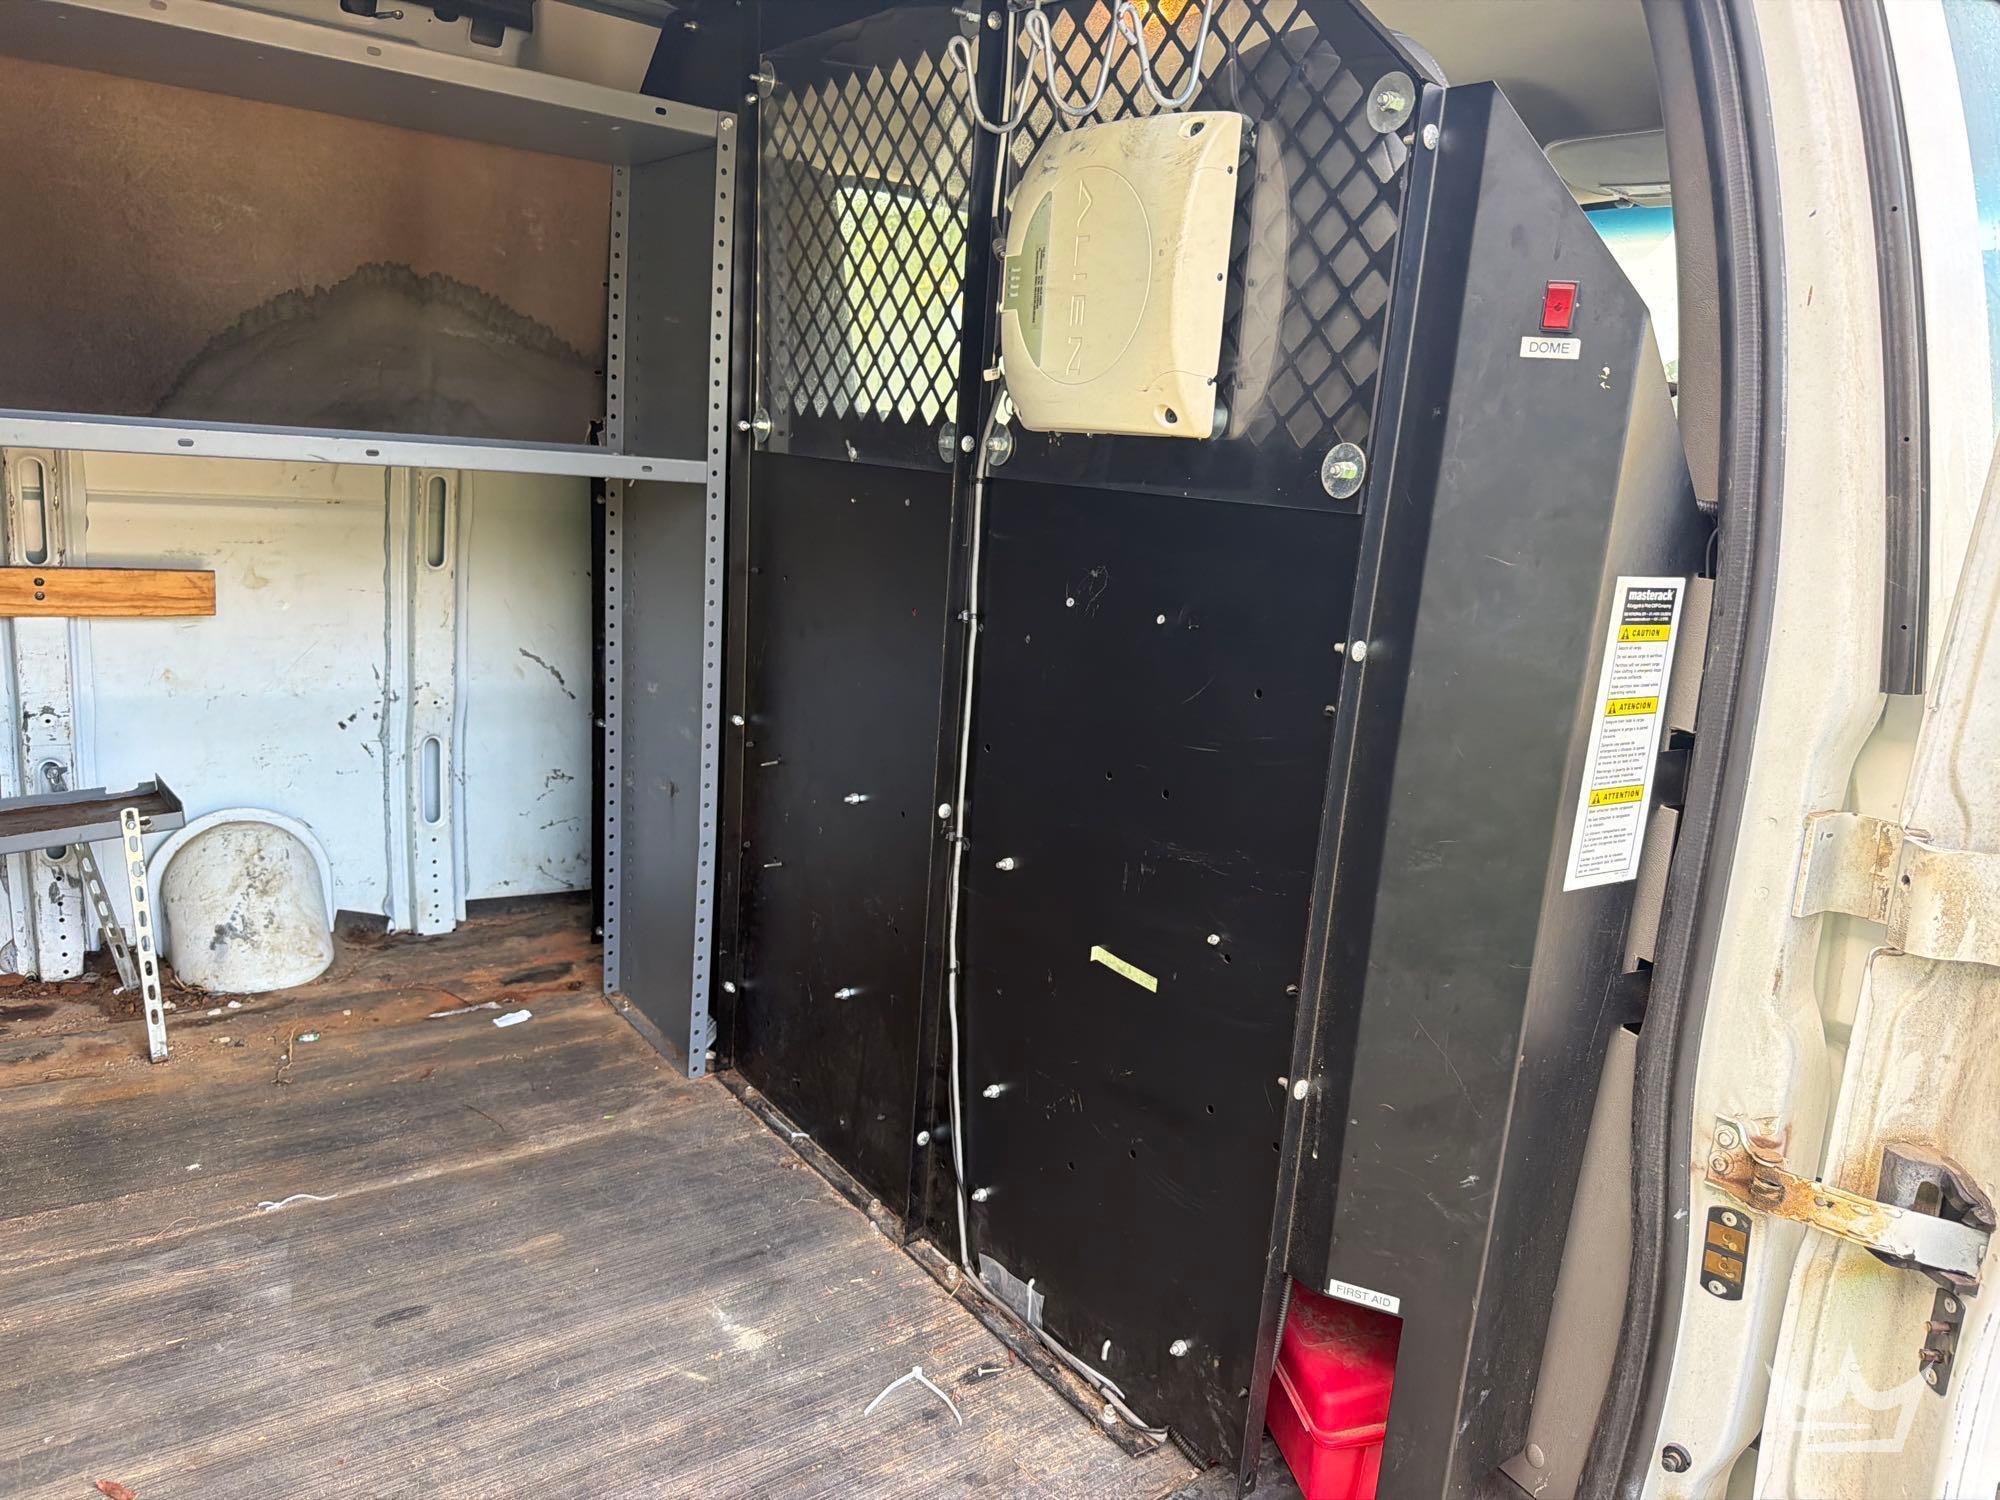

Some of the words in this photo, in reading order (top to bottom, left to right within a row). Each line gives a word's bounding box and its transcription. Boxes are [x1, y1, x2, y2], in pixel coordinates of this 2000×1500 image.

[1529, 342, 1571, 354] DOME
[1628, 589, 1673, 601] masterack
[1632, 629, 1660, 637] CAUTION
[1618, 702, 1652, 711] ATENCION
[1603, 789, 1640, 801] ATTENTION
[1336, 1284, 1369, 1301] FIRST
[1371, 1295, 1391, 1307] AID
